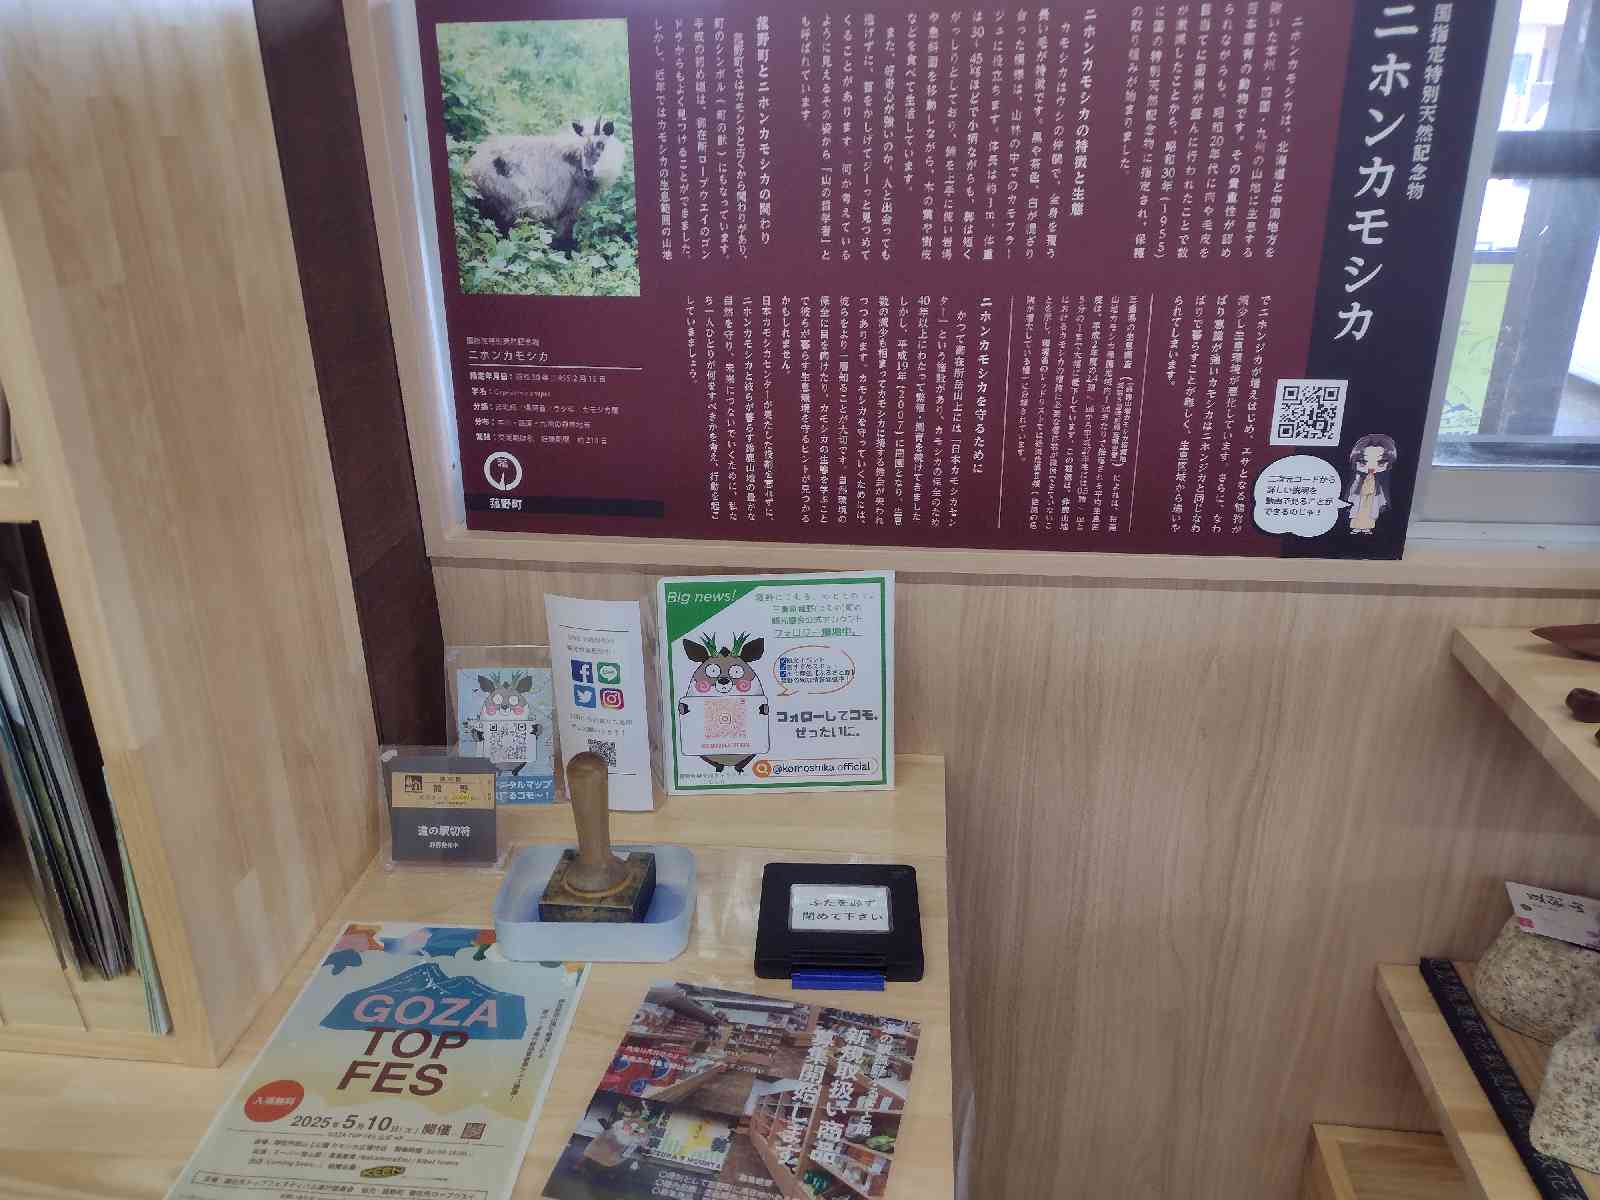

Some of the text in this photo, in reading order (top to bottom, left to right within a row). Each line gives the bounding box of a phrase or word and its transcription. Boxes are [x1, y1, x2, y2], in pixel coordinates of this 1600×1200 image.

[1071, 9, 1096, 216] ニホンカモシカの特徴と生態
[1406, 3, 1453, 200] 国指定特別天然記念物
[1334, 4, 1418, 340] ニホンカモシカ
[781, 296, 792, 375] かもしれません。
[468, 350, 549, 362] ニホンカモシカ
[972, 296, 993, 474] ニホンカモシカを守るために
[667, 589, 737, 605] Big news!
[802, 911, 883, 921] 閉めて下さい
[353, 995, 498, 1029] GOZA
[363, 1028, 469, 1060] TOP
[336, 1060, 449, 1097] FES
